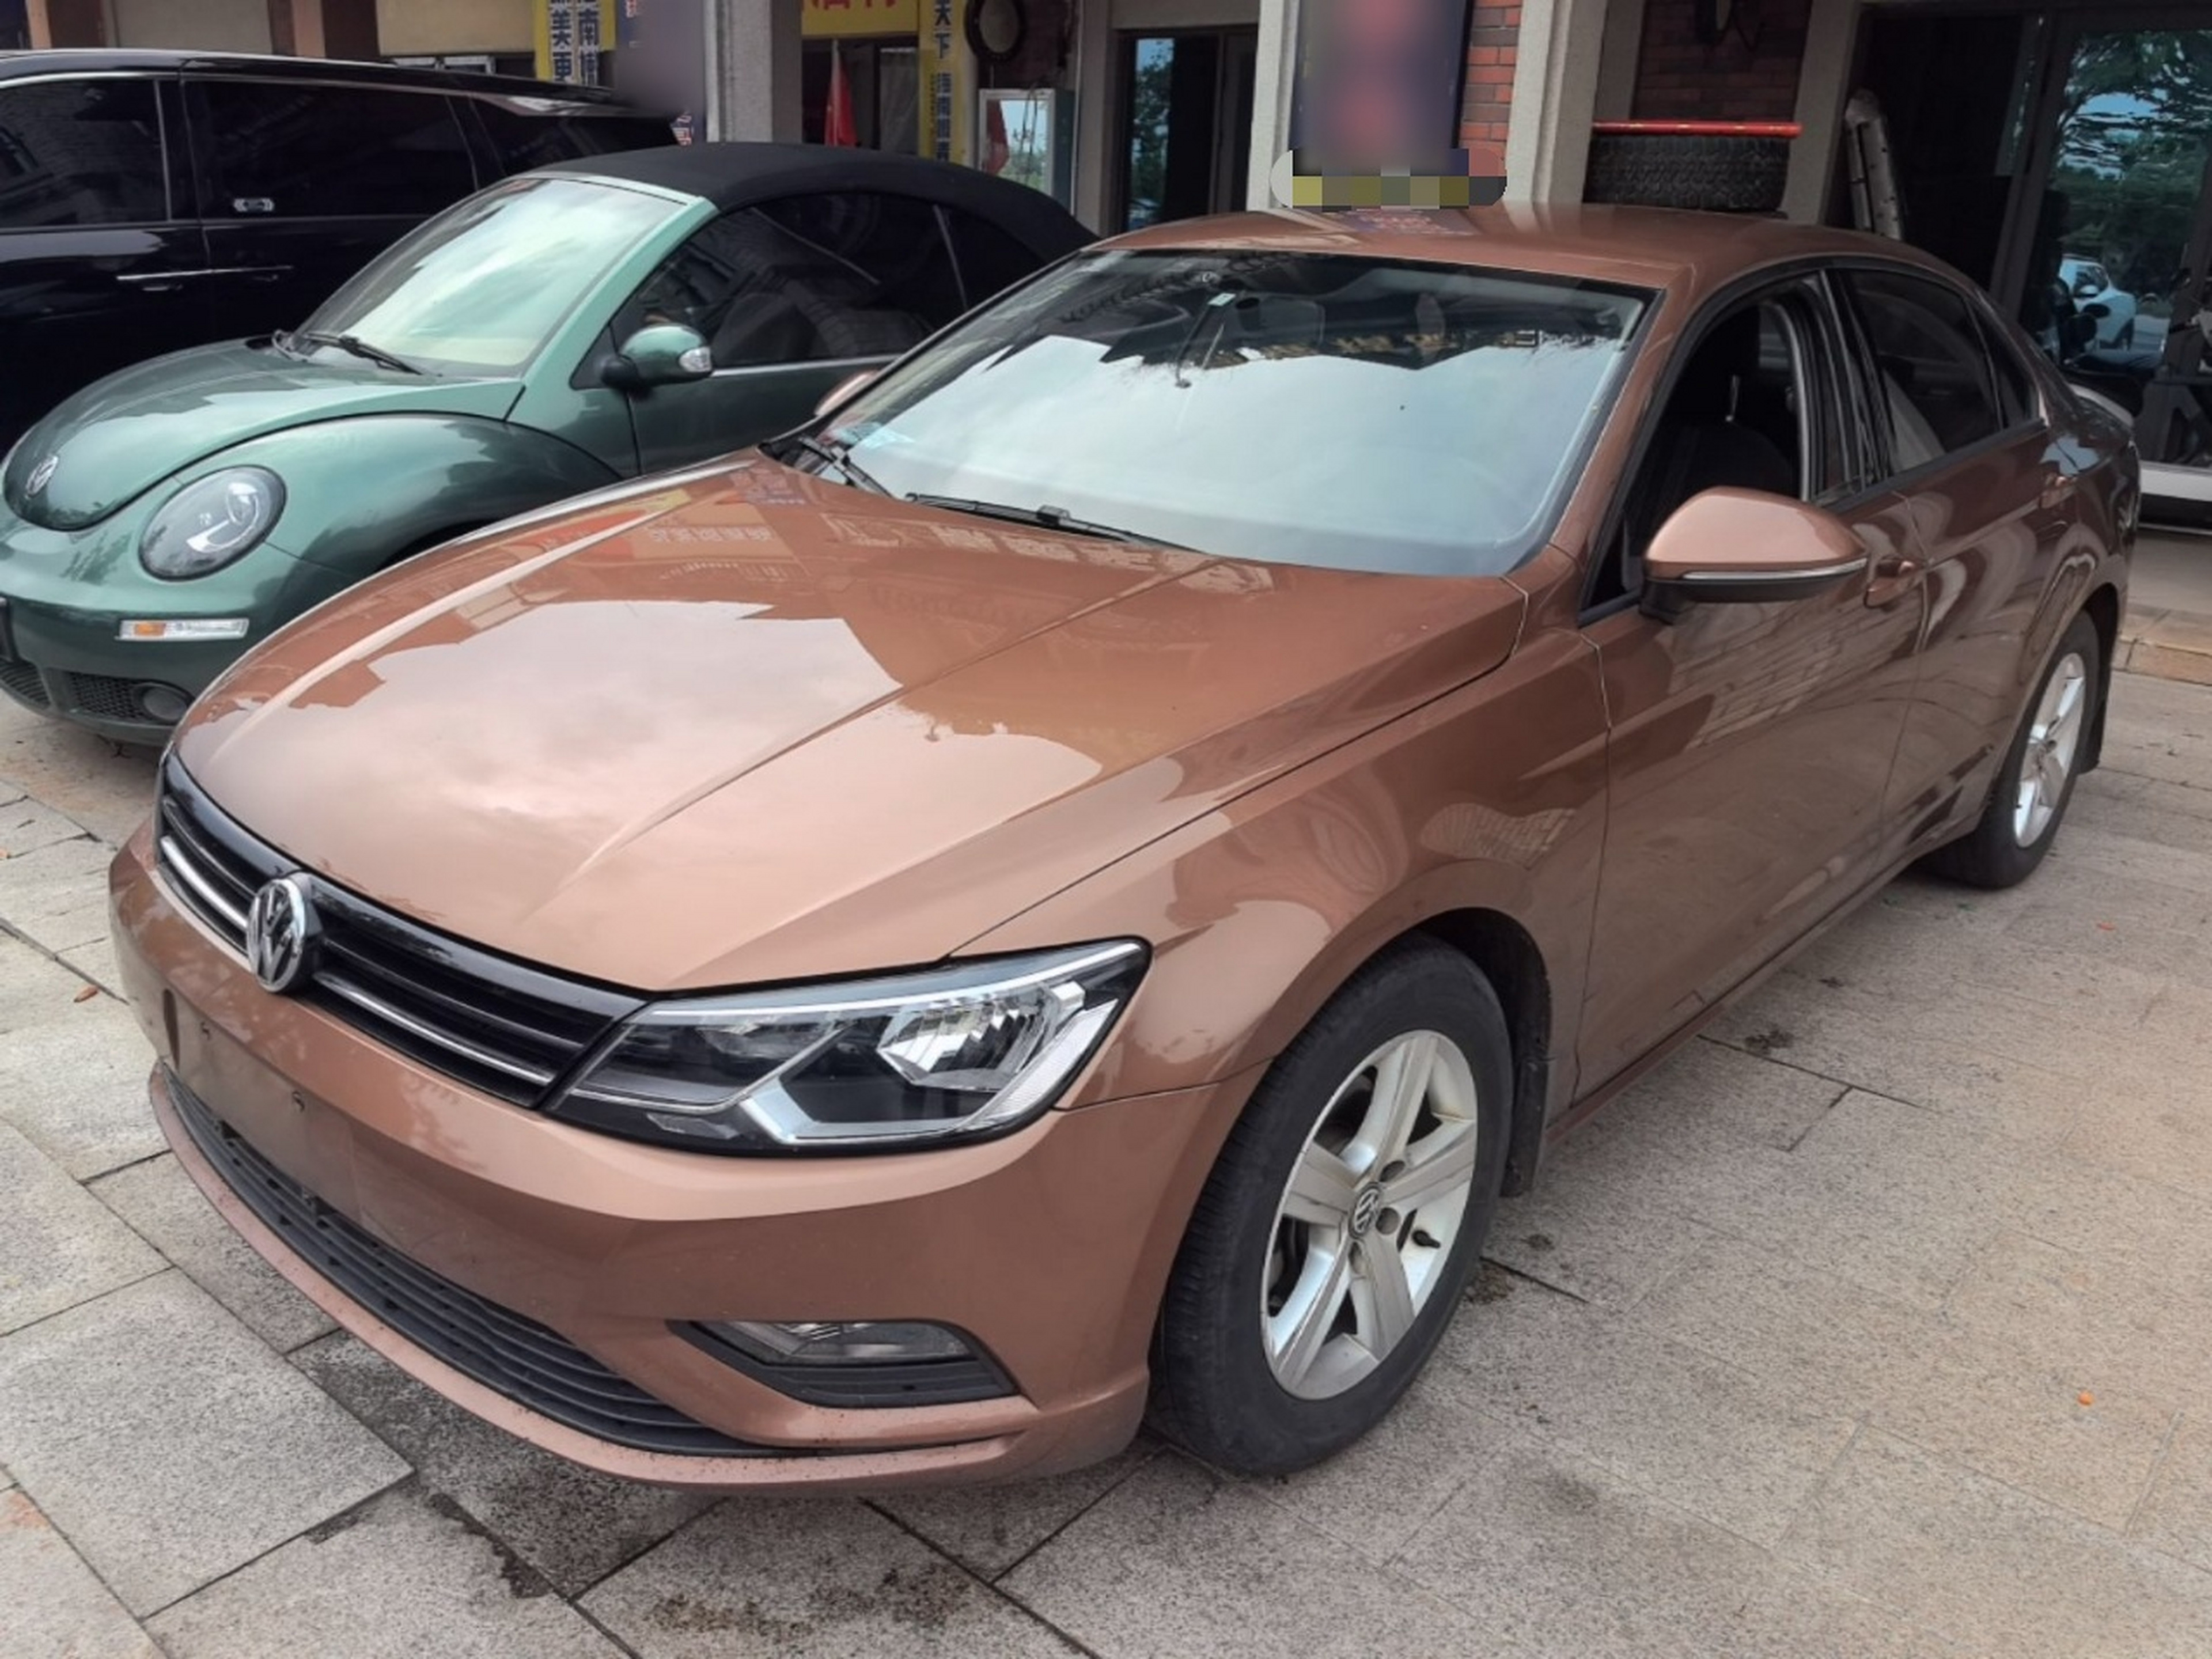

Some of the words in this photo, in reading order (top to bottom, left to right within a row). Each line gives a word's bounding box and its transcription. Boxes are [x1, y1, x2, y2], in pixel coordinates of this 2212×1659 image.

[551, 0, 572, 82] 美更
[578, 0, 599, 86] 南情
[247, 878, 305, 992] VW
